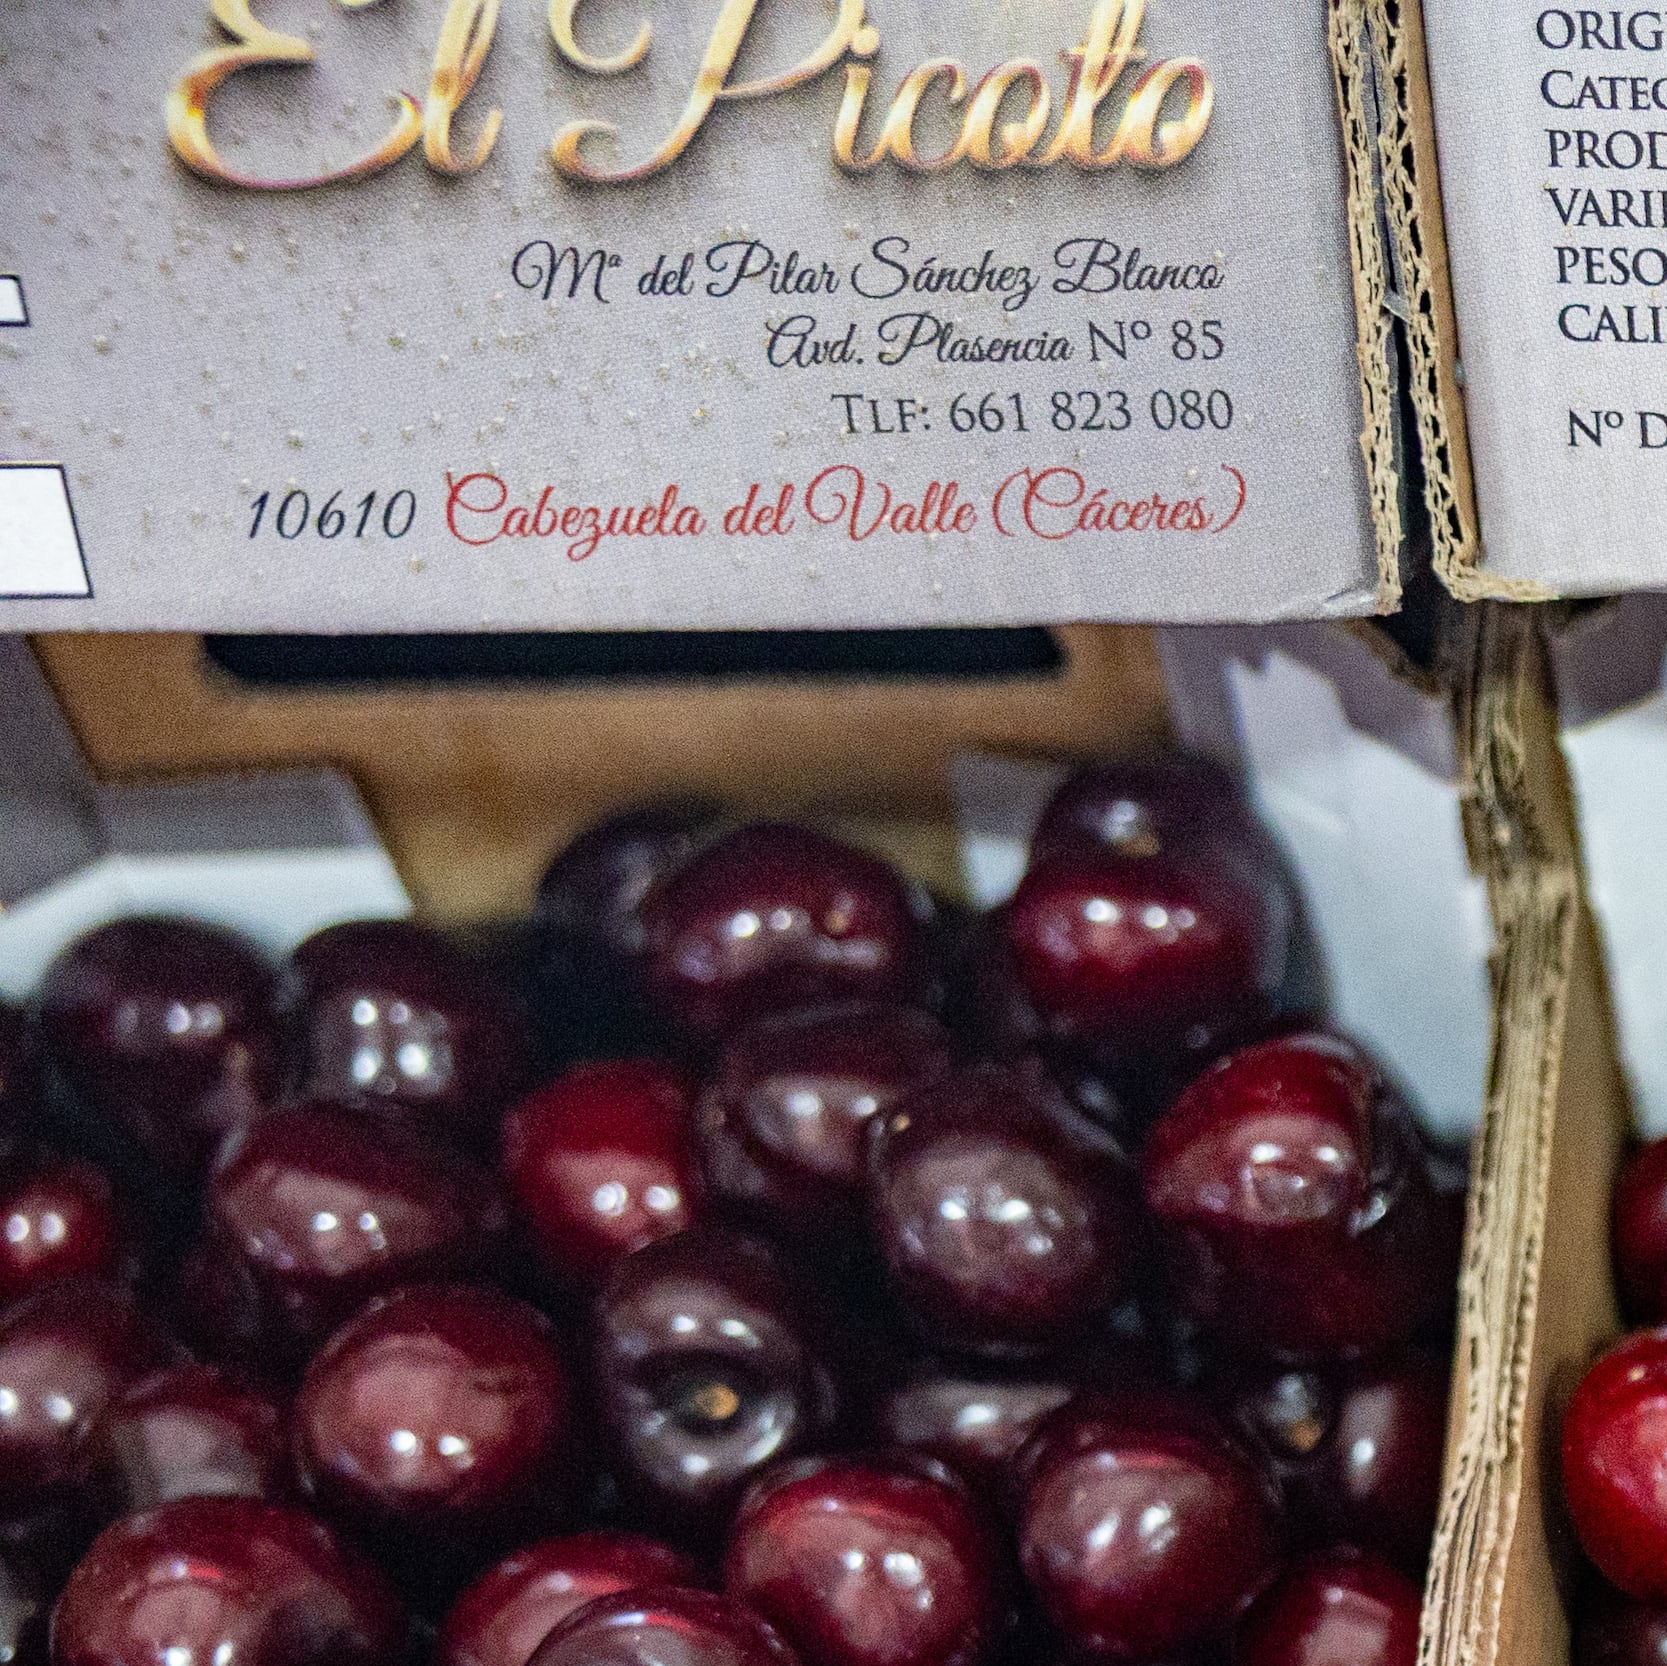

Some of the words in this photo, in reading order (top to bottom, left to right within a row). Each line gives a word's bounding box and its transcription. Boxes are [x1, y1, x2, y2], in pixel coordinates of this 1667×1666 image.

[638, 252, 695, 296] del
[704, 237, 839, 298] Pilar
[851, 236, 1039, 312] Sánchez
[1053, 236, 1226, 295] Blanco
[766, 315, 864, 369] Avd.
[877, 312, 1075, 364] Plasencia
[1172, 319, 1225, 361] 85
[950, 390, 1027, 432] 661
[1050, 390, 1132, 432] 823
[1150, 389, 1234, 430] 080
[248, 489, 418, 540] 10610
[445, 471, 705, 561] Cabezuela
[723, 484, 795, 537] del
[805, 465, 977, 541] Valle
[993, 464, 1249, 540] (Cáceres)
